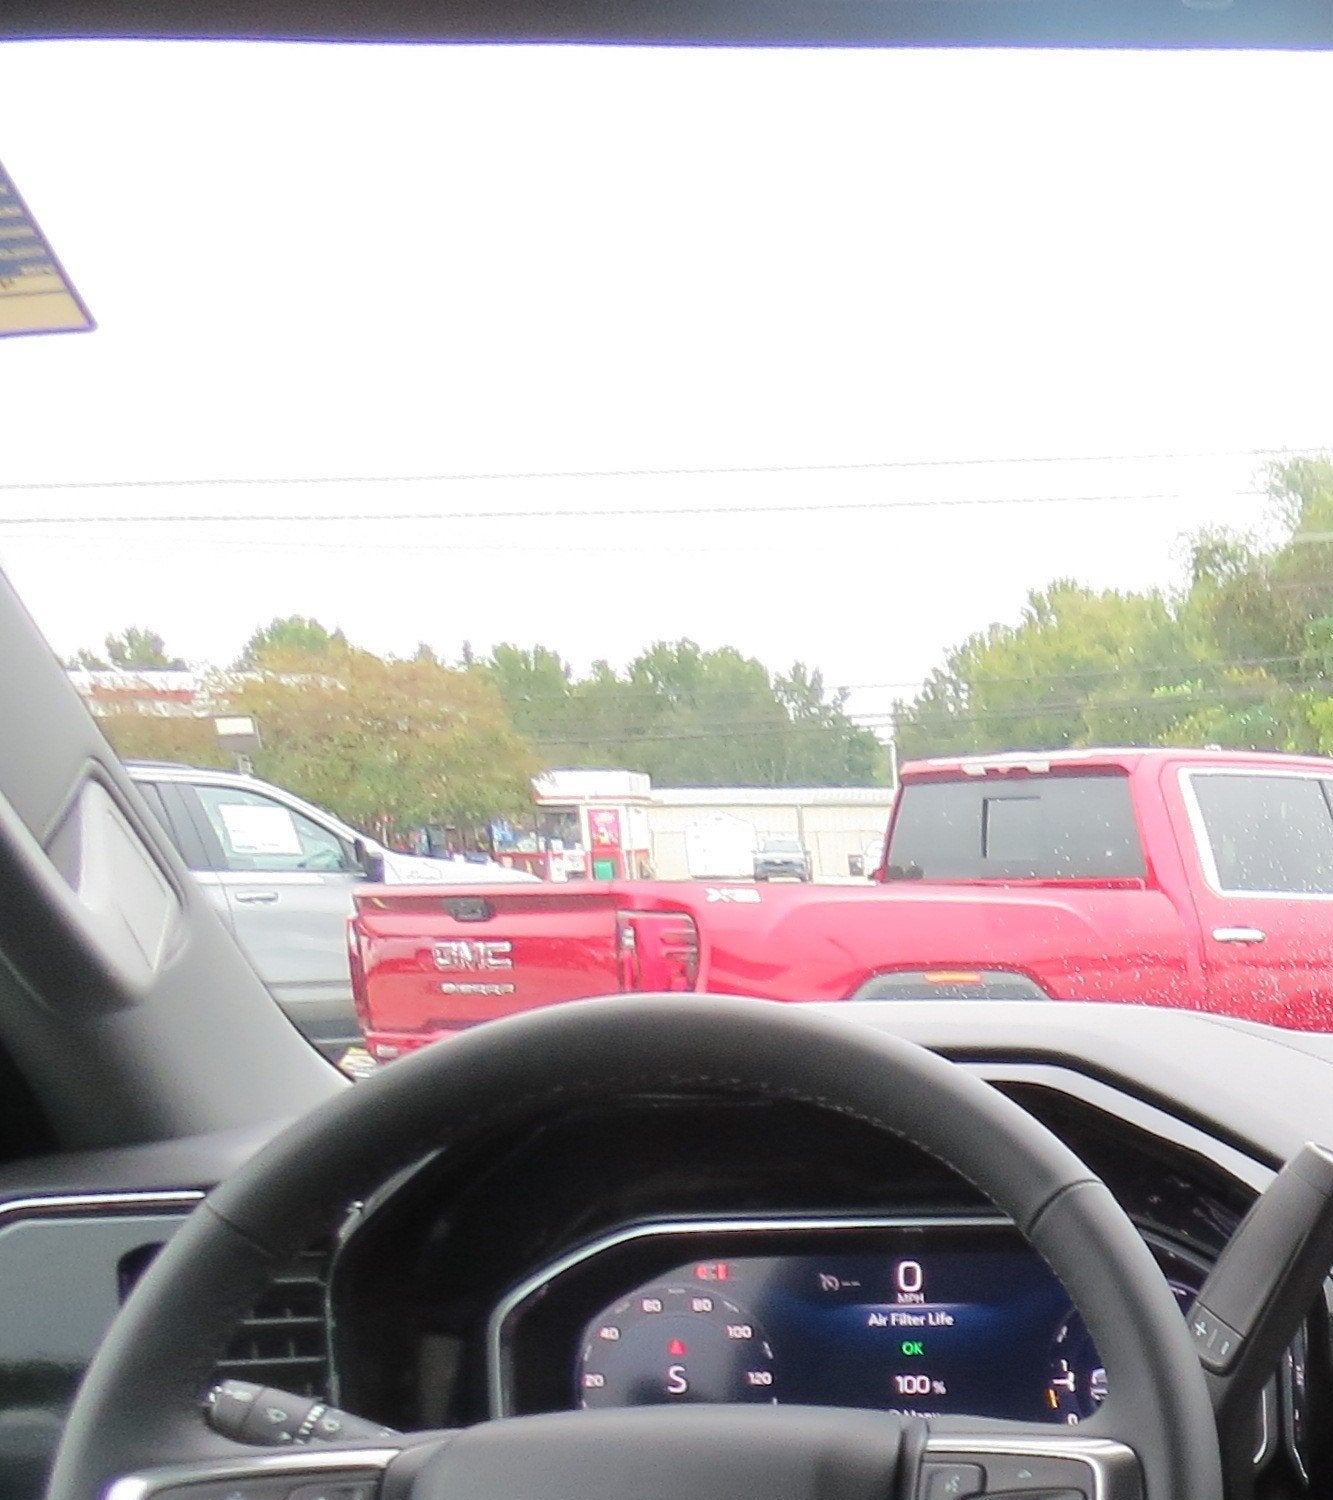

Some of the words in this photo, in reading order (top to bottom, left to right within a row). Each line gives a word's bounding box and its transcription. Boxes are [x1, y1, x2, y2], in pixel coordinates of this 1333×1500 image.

[433, 941, 514, 972] GMC
[898, 1260, 924, 1293] 0
[897, 1292, 925, 1303] MPH
[868, 1313, 888, 1327] Air
[891, 1312, 925, 1327] Filter
[928, 1311, 955, 1326] Life
[600, 1326, 621, 1341] 40
[725, 1324, 753, 1340] 100
[901, 1341, 925, 1356] OK
[583, 1373, 605, 1388] 20
[667, 1364, 688, 1395] S
[747, 1370, 774, 1387] 120
